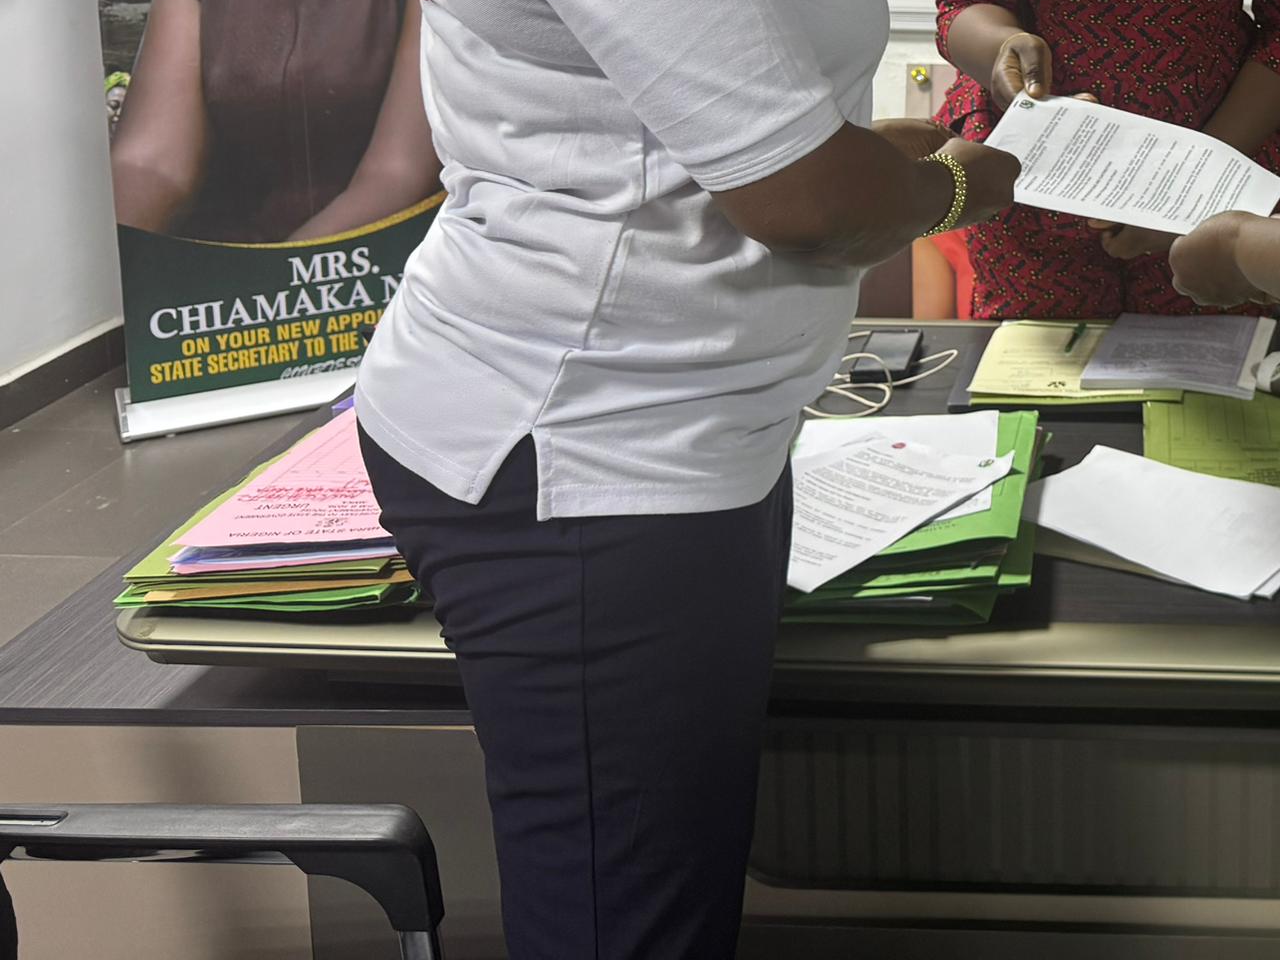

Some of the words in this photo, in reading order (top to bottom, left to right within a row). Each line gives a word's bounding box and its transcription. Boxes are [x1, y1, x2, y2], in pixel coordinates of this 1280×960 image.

[288, 246, 380, 287] MRS.
[150, 279, 376, 340] CHIAMAKA
[150, 358, 203, 384] STATE
[207, 340, 300, 375] SECRETARY
[303, 336, 326, 358] TO
[331, 331, 360, 353] THE
[181, 336, 210, 358] ON
[217, 327, 271, 352] YOUR
[276, 319, 321, 343] NEW
[254, 503, 310, 511] URGENT
